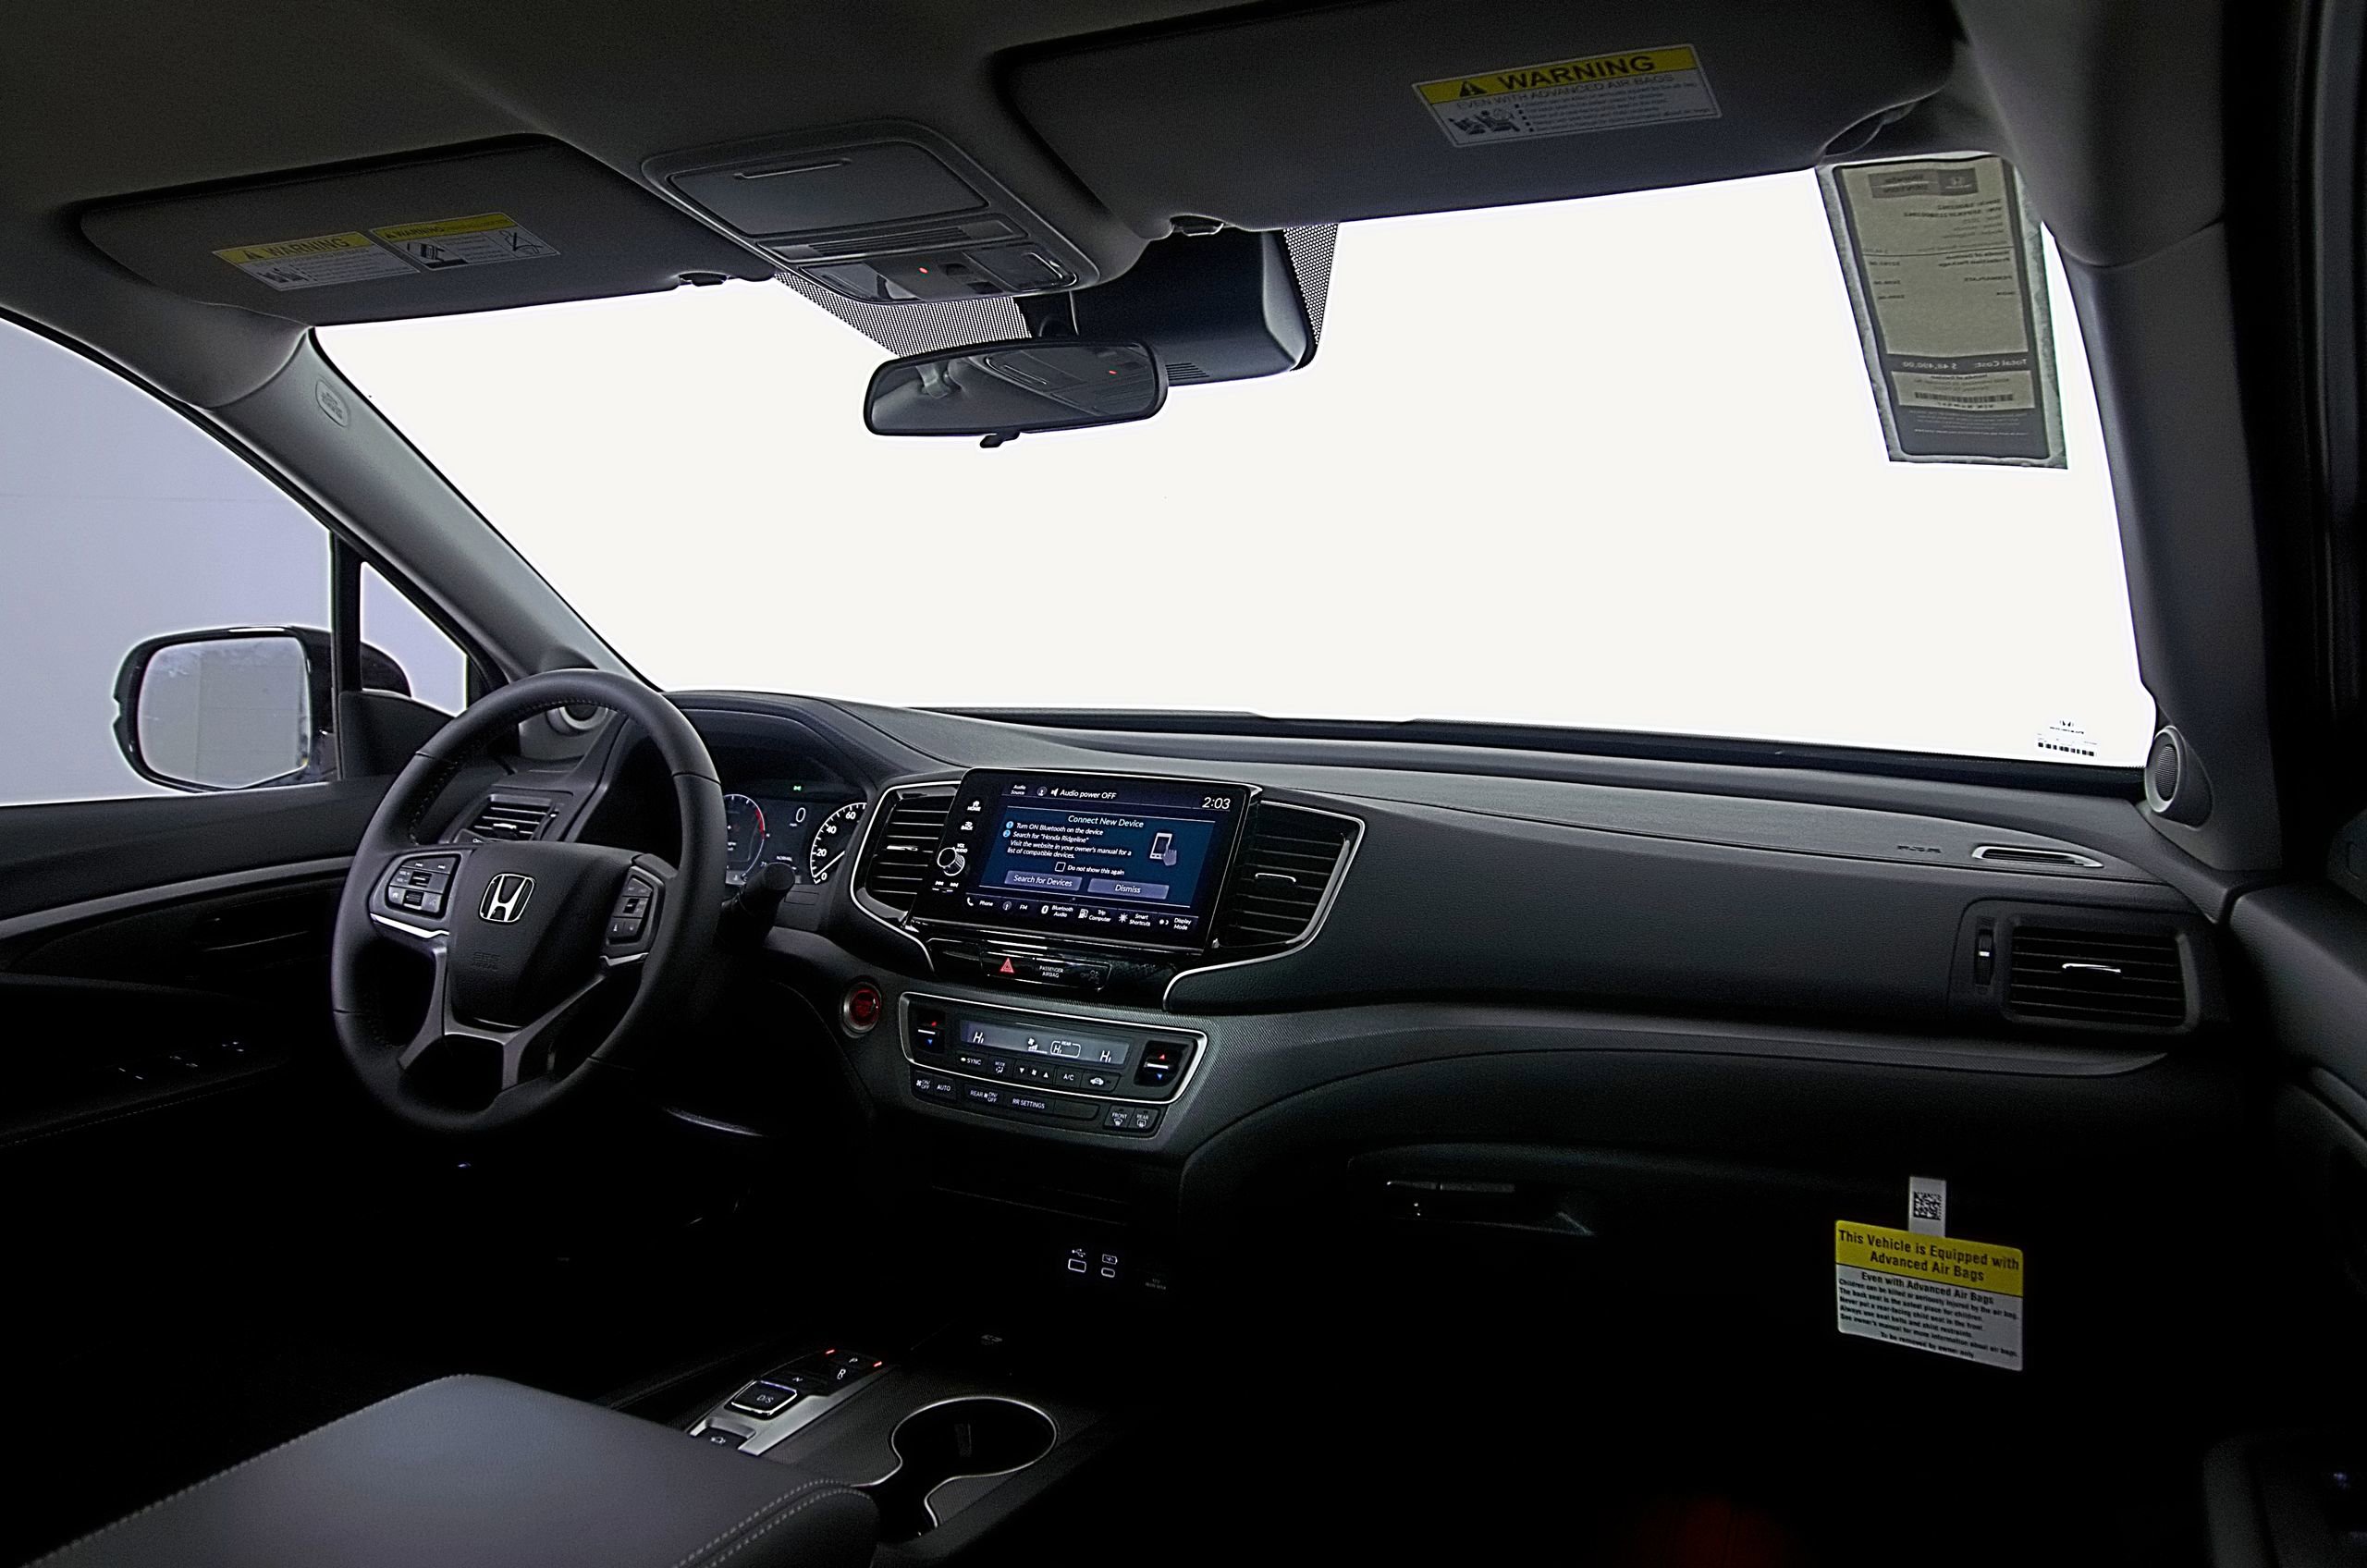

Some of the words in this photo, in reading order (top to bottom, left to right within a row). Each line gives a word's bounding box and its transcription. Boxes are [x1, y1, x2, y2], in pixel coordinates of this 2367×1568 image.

[1497, 55, 1656, 90] WARNING
[1530, 81, 1605, 99] ADVANCED
[1608, 79, 1629, 89] AIR
[1634, 74, 1674, 85] BAGS
[265, 238, 350, 256] WARNING
[1060, 789, 1079, 797] Audio
[1202, 797, 1231, 810] 2:03
[795, 807, 806, 823] 0
[845, 812, 856, 820] 60
[1068, 815, 1098, 825] Connect
[1099, 816, 1117, 826] New
[1119, 818, 1144, 828] Device
[826, 826, 837, 834] 40
[1039, 824, 1065, 832] Bluetooth
[1061, 835, 1089, 844] Ridgeline"
[1034, 841, 1054, 850] website
[1074, 845, 1096, 853] owner's
[816, 848, 828, 857] 20
[1024, 849, 1052, 858] compatible
[821, 872, 828, 880] 0
[1013, 875, 1036, 884] Search
[1036, 876, 1047, 885] for
[1048, 877, 1073, 887] Devices
[1115, 884, 1141, 893] Dismiss
[1051, 904, 1073, 913] Bluetooth
[1088, 914, 1111, 923] Computer
[1039, 965, 1064, 974] PASSENGER
[1020, 1099, 1046, 1109] SETTINGS
[1839, 1230, 1864, 1243] This
[1868, 1234, 1911, 1253] Vehicle
[1916, 1243, 1926, 1255] is
[1931, 1245, 1987, 1265] Equipped
[1992, 1256, 2019, 1270] with
[1870, 1251, 1928, 1271] Advanced
[1932, 1262, 1950, 1274] Air
[1954, 1266, 1984, 1281] Bags
[1839, 1279, 1864, 1288] Children
[1862, 1272, 1883, 1283] Even
[1885, 1278, 1904, 1287] with
[1907, 1280, 1951, 1296] Advanced
[1971, 1292, 1994, 1305] Bags
[837, 1368, 846, 1380] R
[756, 1394, 774, 1404] D/S
